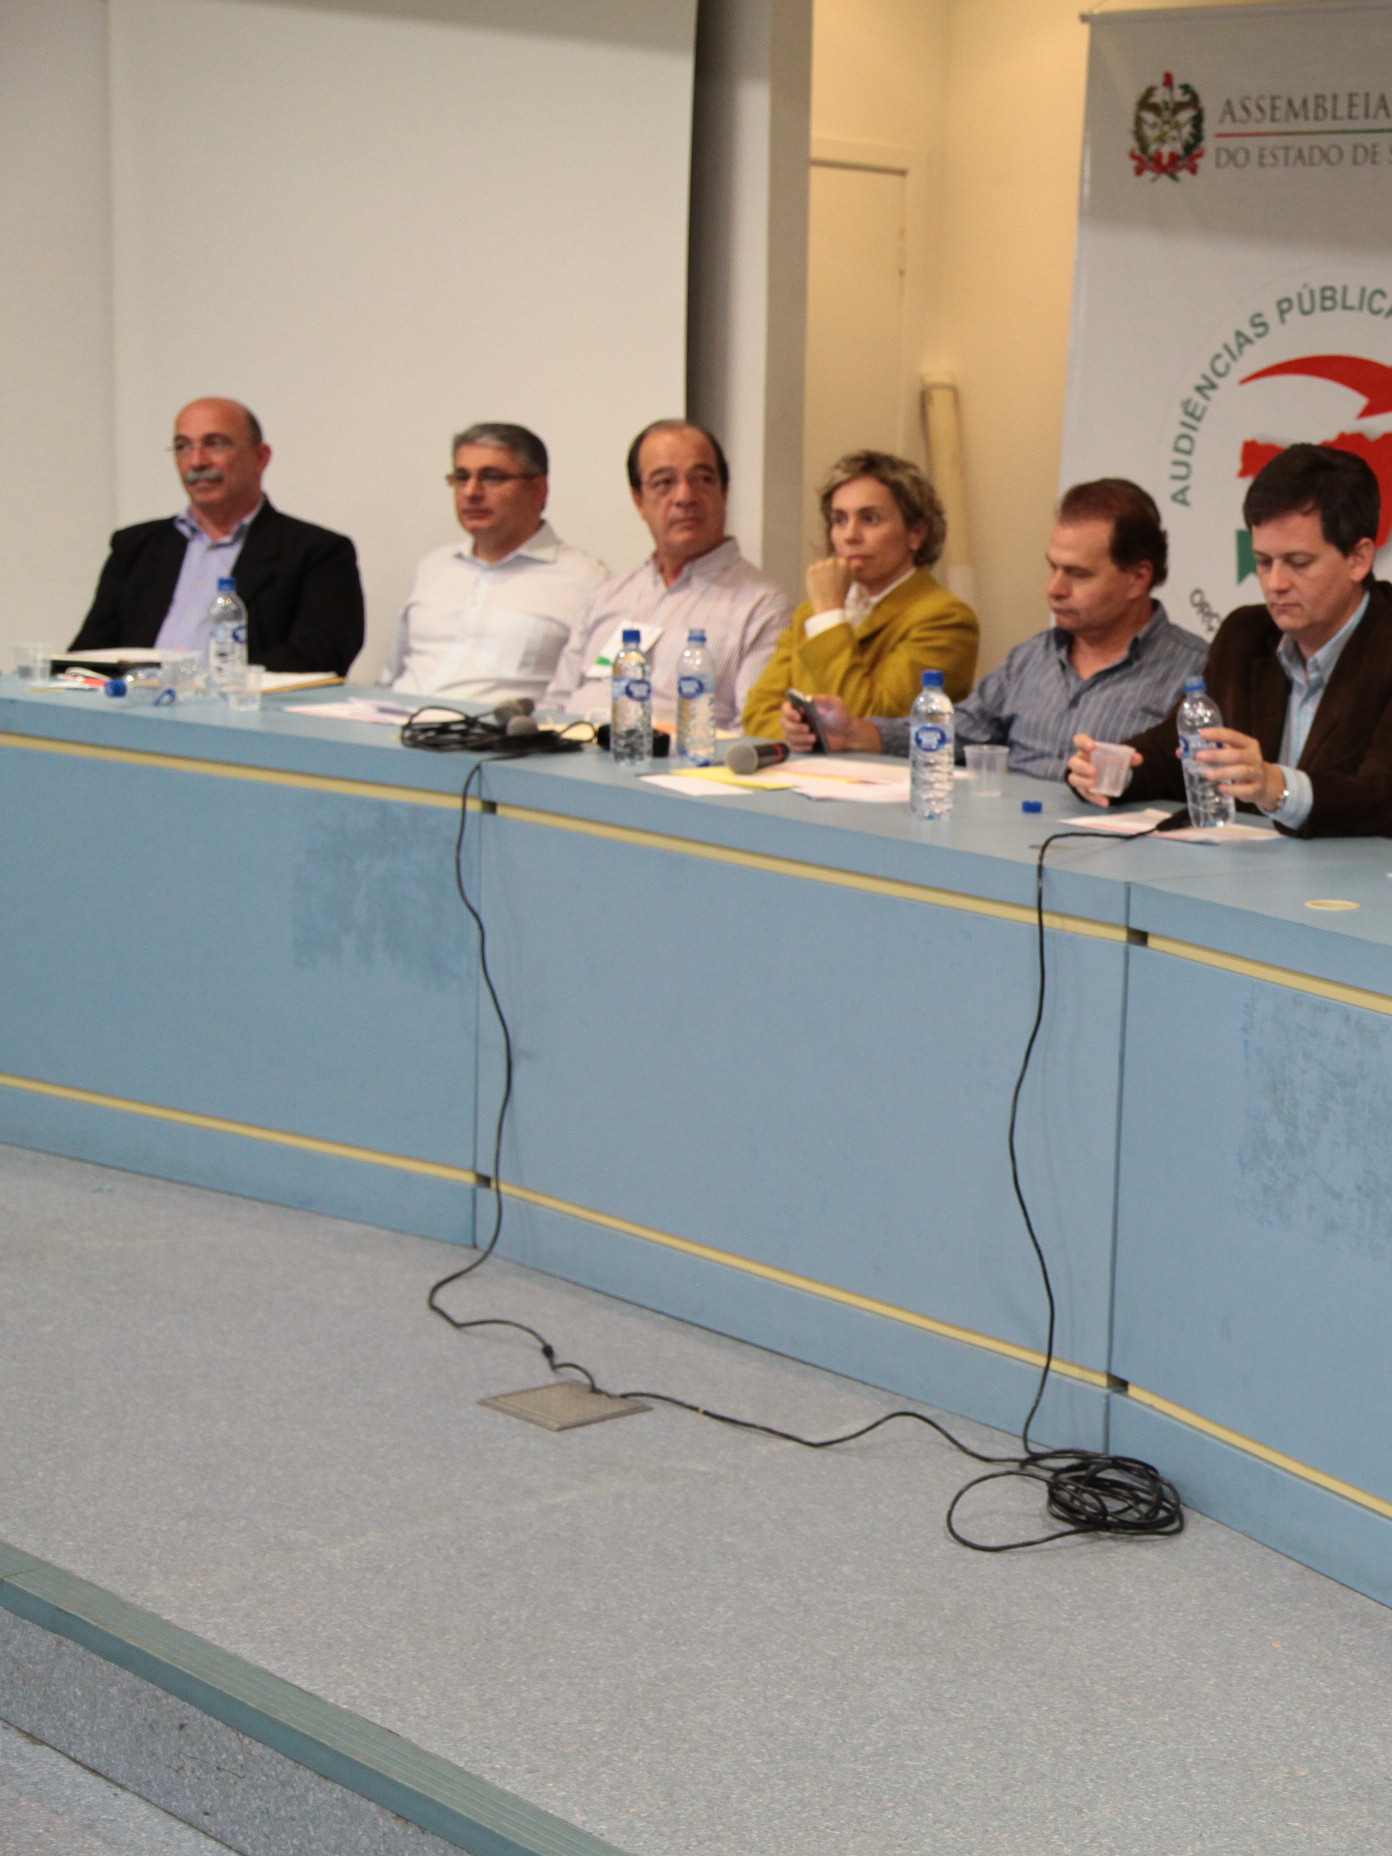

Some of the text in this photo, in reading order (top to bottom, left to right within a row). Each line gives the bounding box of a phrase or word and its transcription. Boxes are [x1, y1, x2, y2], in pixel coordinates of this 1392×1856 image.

[1219, 90, 1392, 126] ASSEMBLEIA
[1214, 146, 1251, 170] DO
[1257, 144, 1344, 169] ESTADO
[1351, 142, 1381, 167] DE
[1170, 312, 1271, 508] AUDIÊNCIAS
